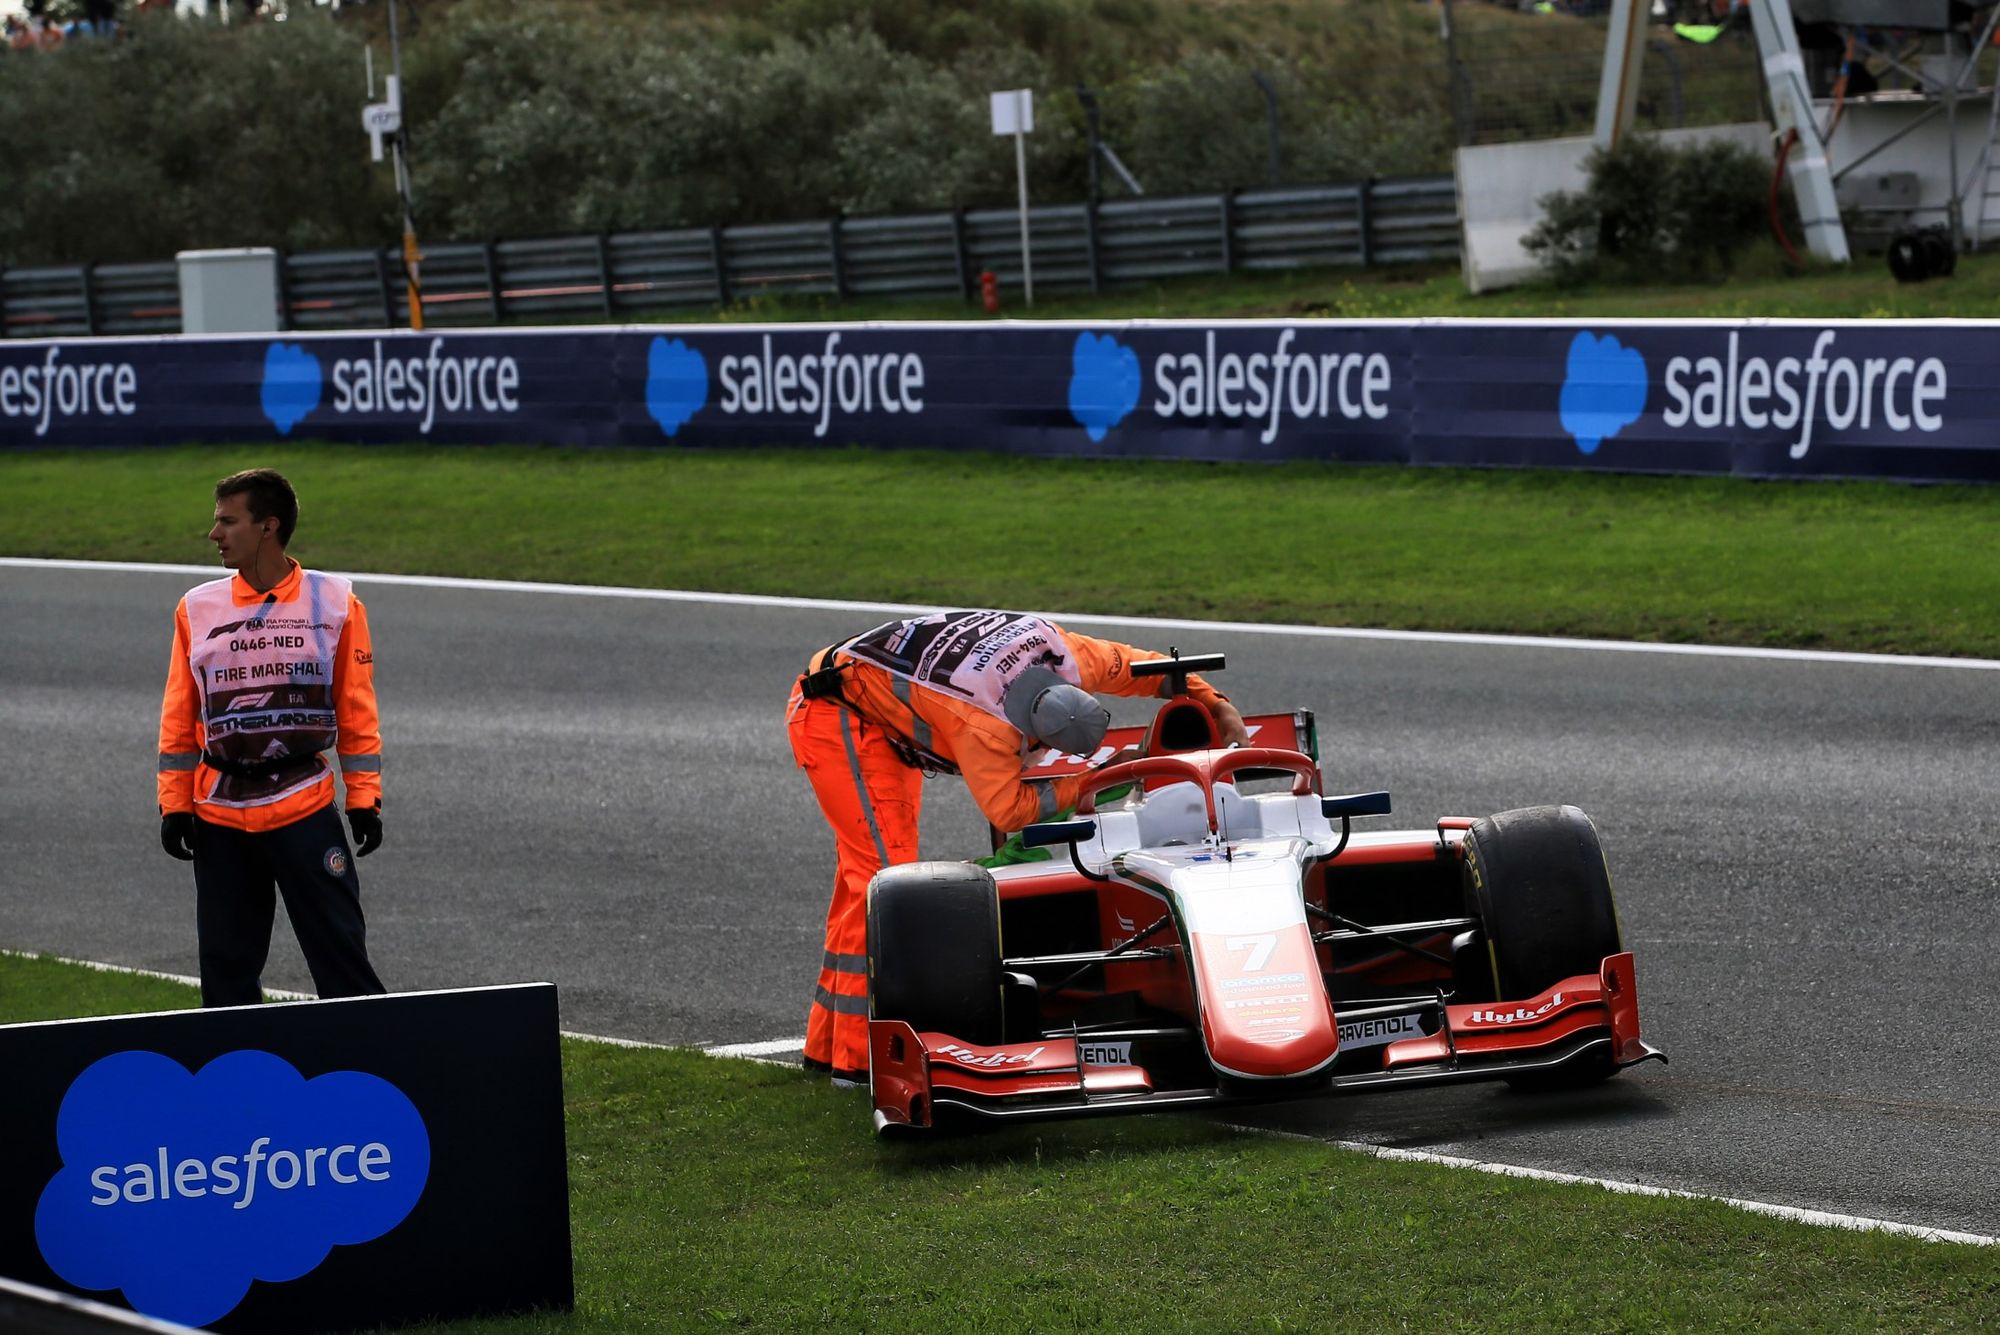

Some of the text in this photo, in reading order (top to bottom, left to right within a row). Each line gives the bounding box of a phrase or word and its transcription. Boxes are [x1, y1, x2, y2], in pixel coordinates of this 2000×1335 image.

[0, 346, 137, 436] esforce
[333, 337, 520, 434] salesforce
[720, 331, 925, 438] salesforce
[1154, 328, 1393, 445] salesforce
[1662, 331, 1948, 459] salesforce
[229, 636, 305, 652] 0446-NED
[951, 638, 968, 654] FIA
[215, 662, 323, 683] FIRE MARSHAL
[1225, 934, 1277, 972] 7
[1472, 992, 1565, 1024] Hybel
[1338, 1017, 1413, 1043] RAVENOL
[935, 1044, 1045, 1067] Hybel
[1079, 1047, 1127, 1063] ENOL
[91, 1137, 392, 1210] salesforce
